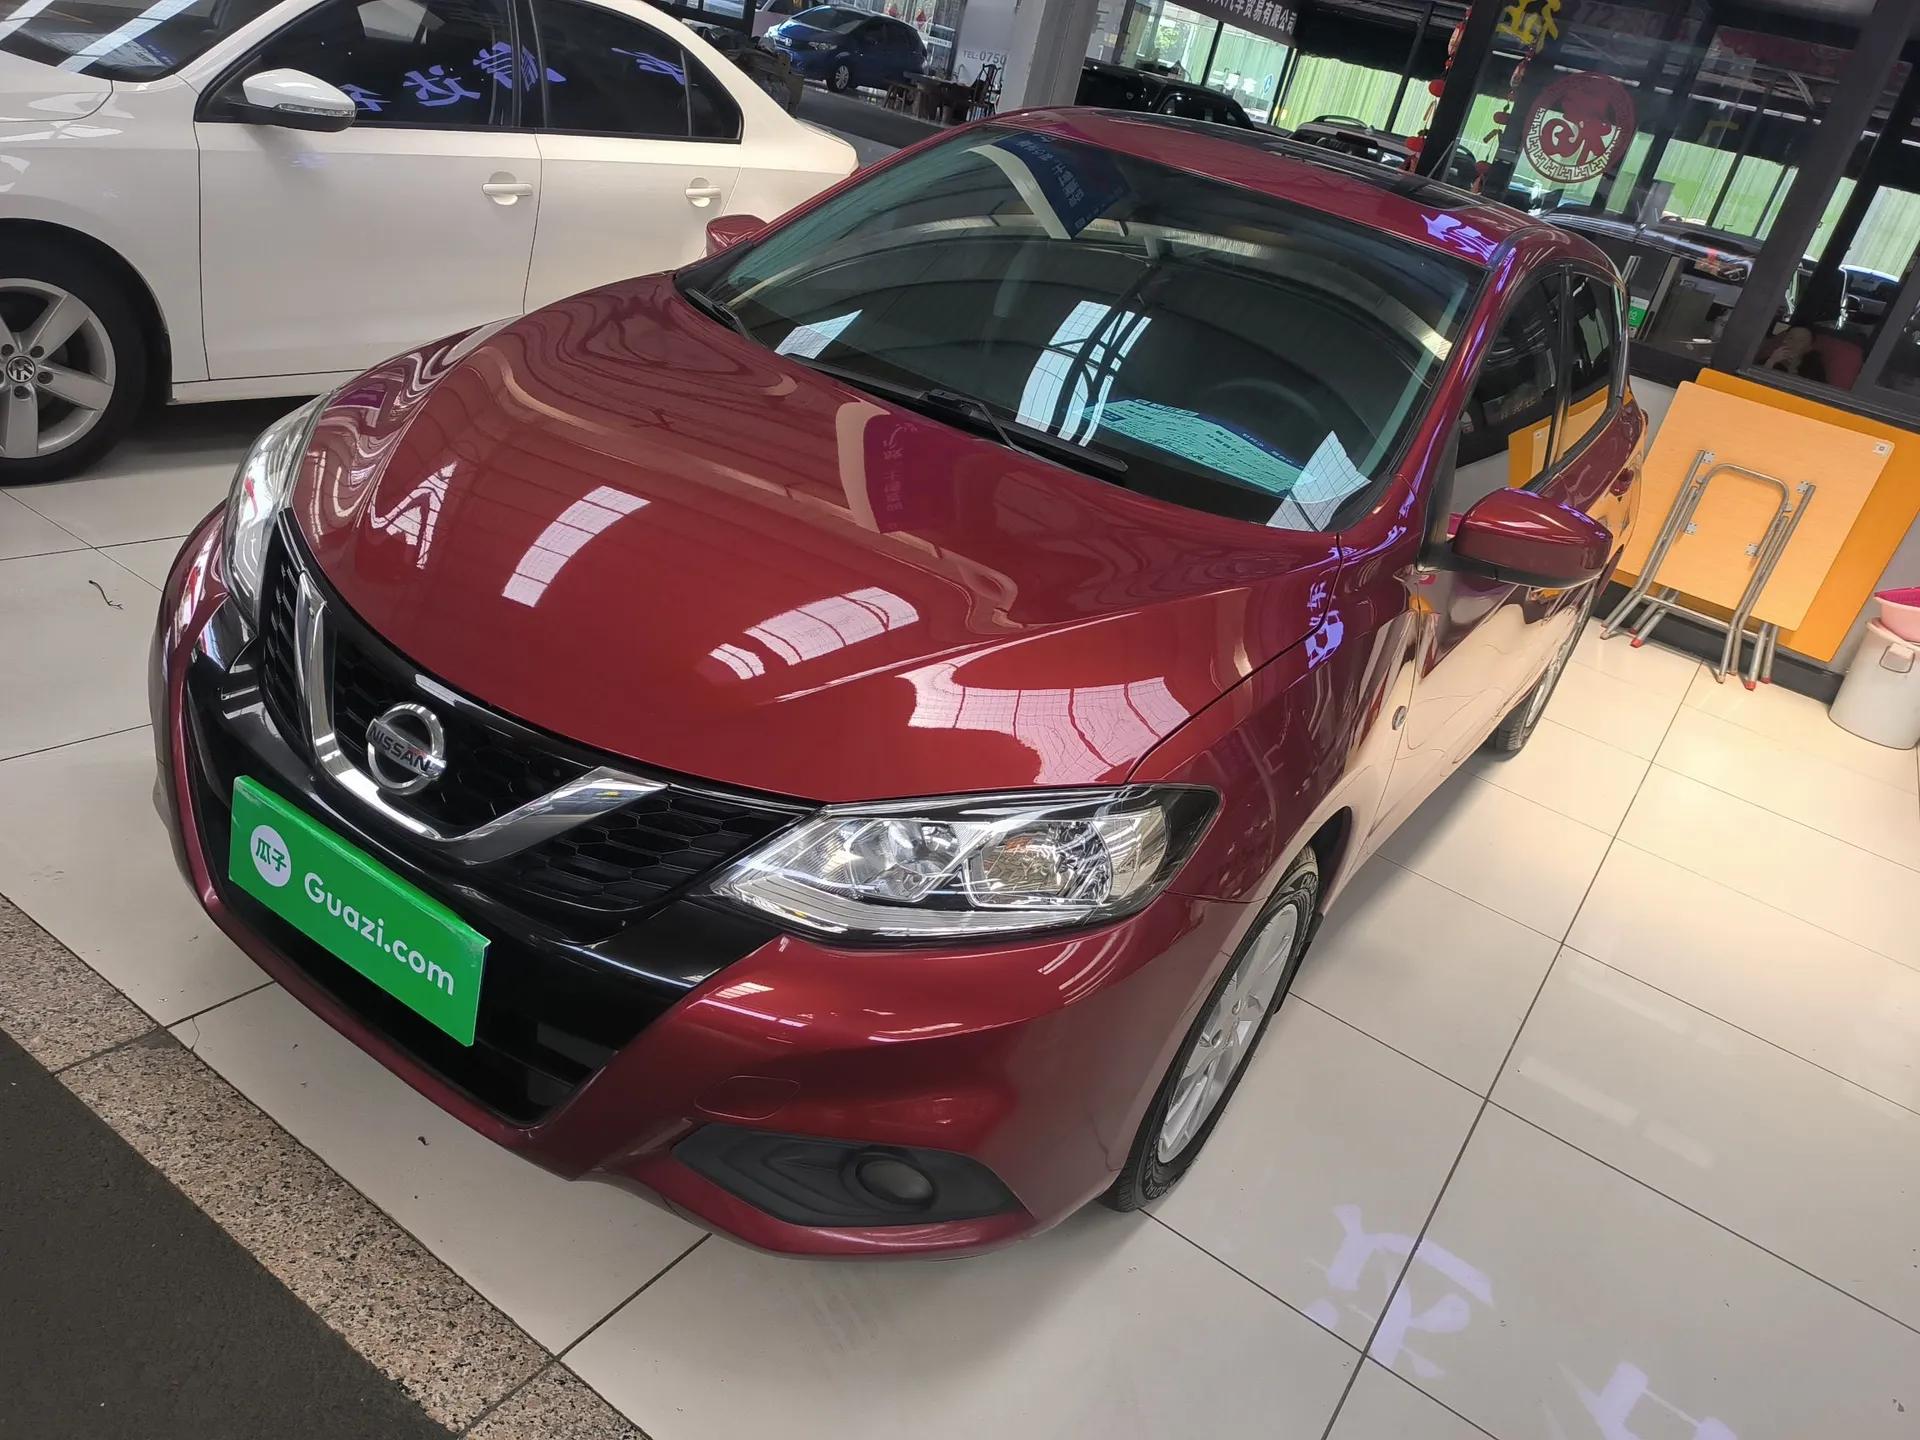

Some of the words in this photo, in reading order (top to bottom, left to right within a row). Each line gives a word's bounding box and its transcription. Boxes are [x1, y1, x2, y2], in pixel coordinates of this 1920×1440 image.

[369, 725, 432, 772] NISSAN
[256, 837, 288, 872] 瓜子
[304, 872, 455, 996] Guazi.com
